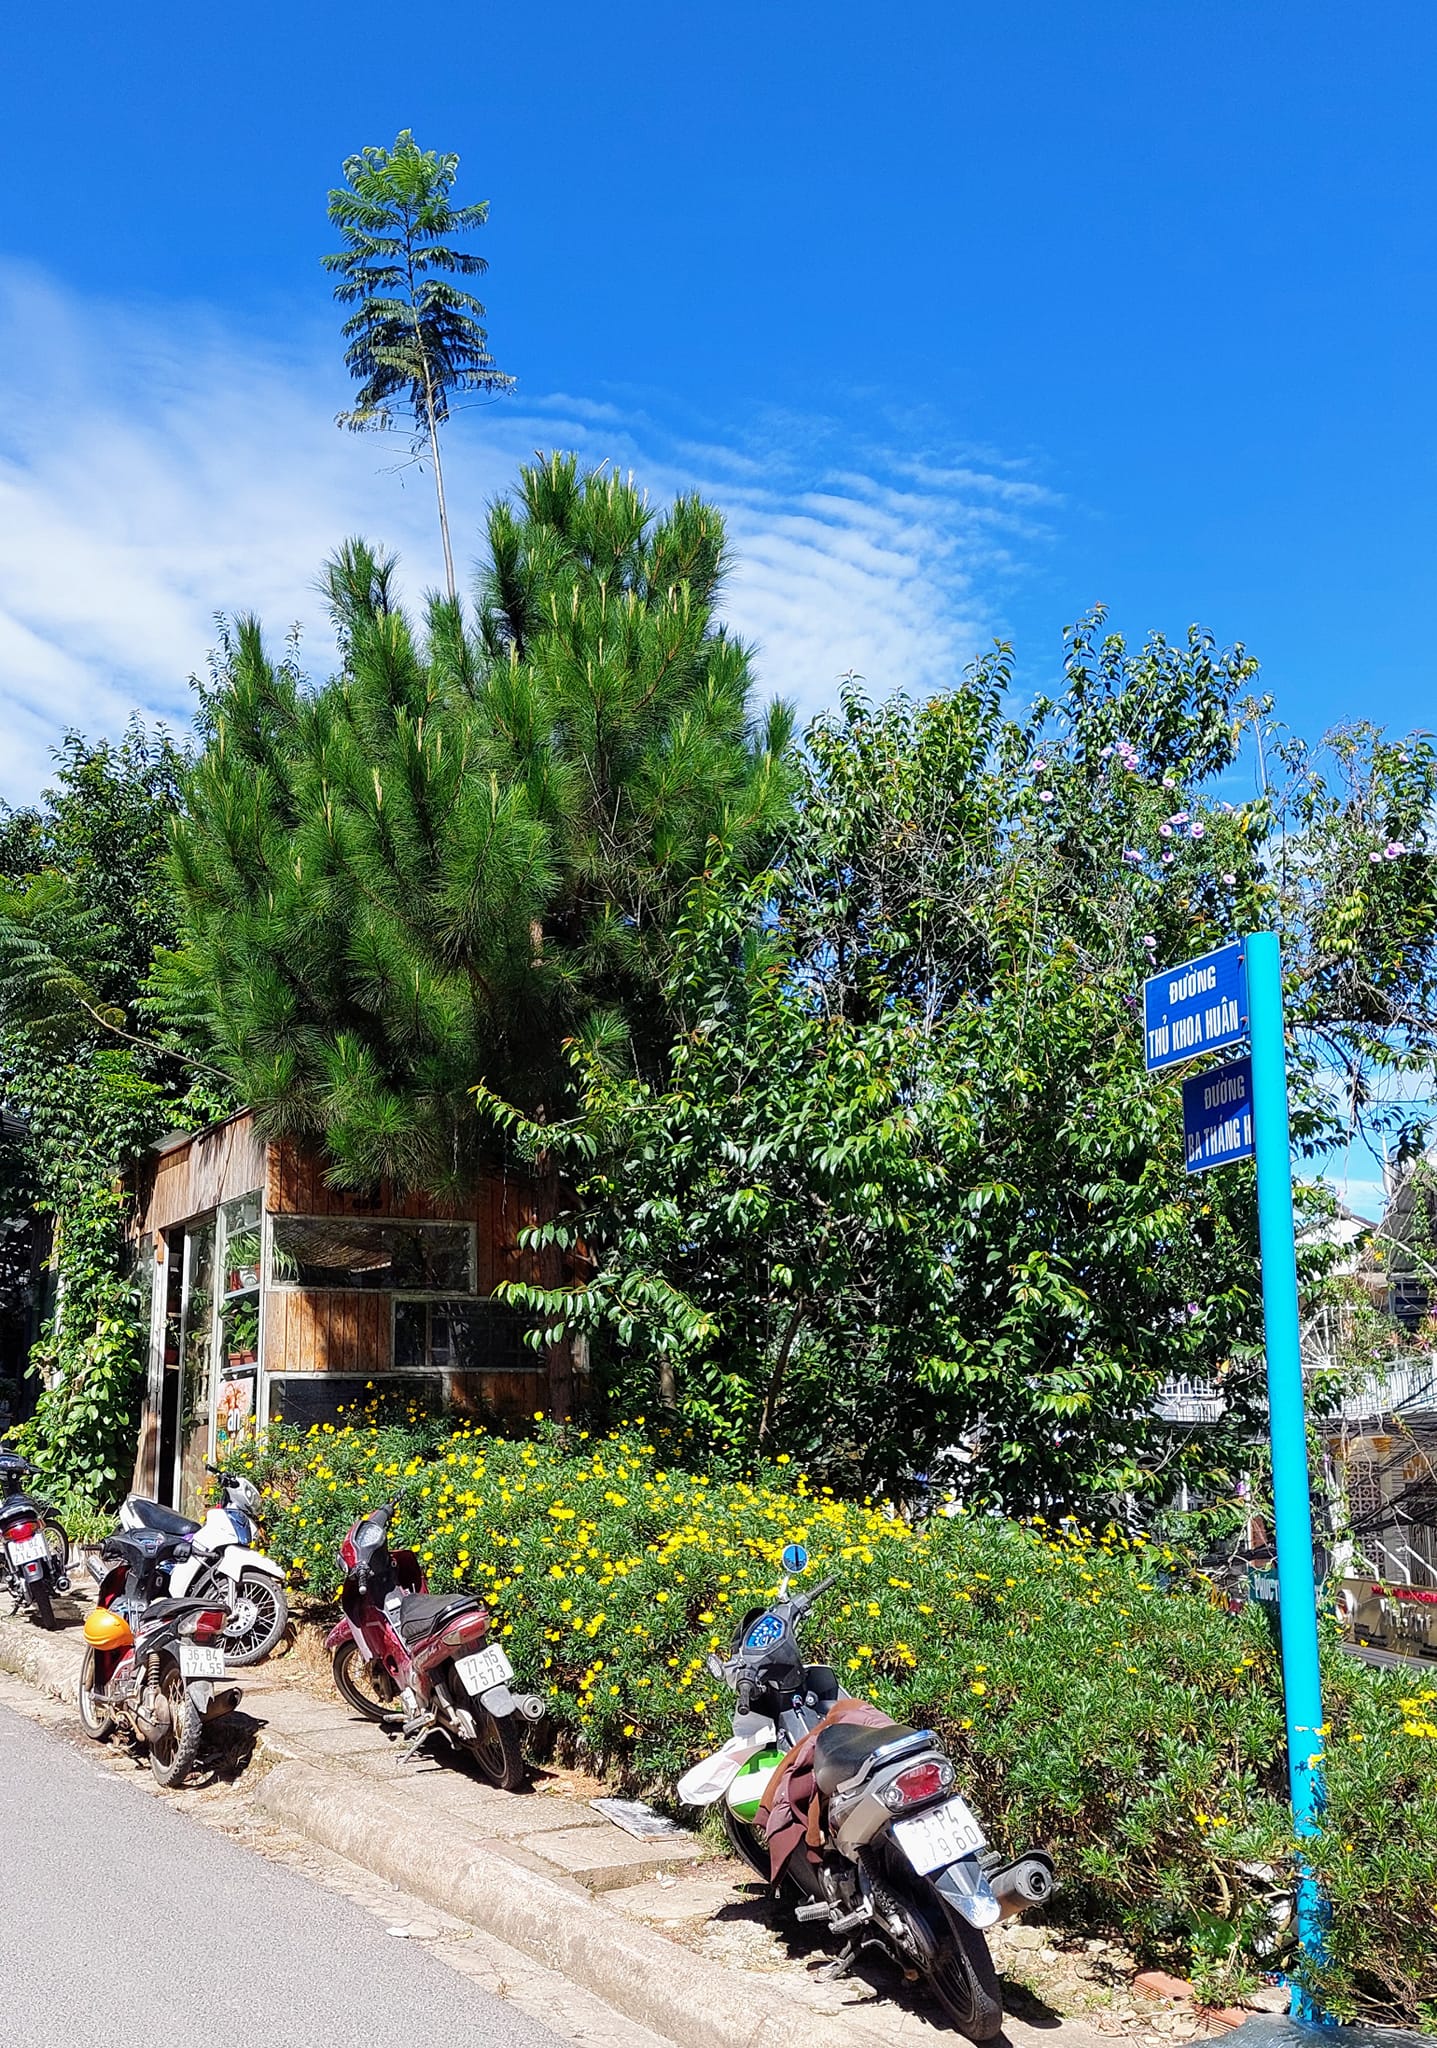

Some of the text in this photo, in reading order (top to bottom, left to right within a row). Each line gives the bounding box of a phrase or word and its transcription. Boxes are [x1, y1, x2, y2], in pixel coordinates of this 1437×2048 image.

[1169, 965, 1217, 1005] ĐƯỜNG
[1148, 996, 1239, 1059] THỦ KHOA HUÂN
[1204, 1071, 1245, 1110] ĐƯỜNG
[1187, 1131, 1202, 1162] BA
[1203, 1114, 1240, 1157] THÁNG
[187, 1648, 218, 1661] 36-B4
[470, 1664, 506, 1691] 7573
